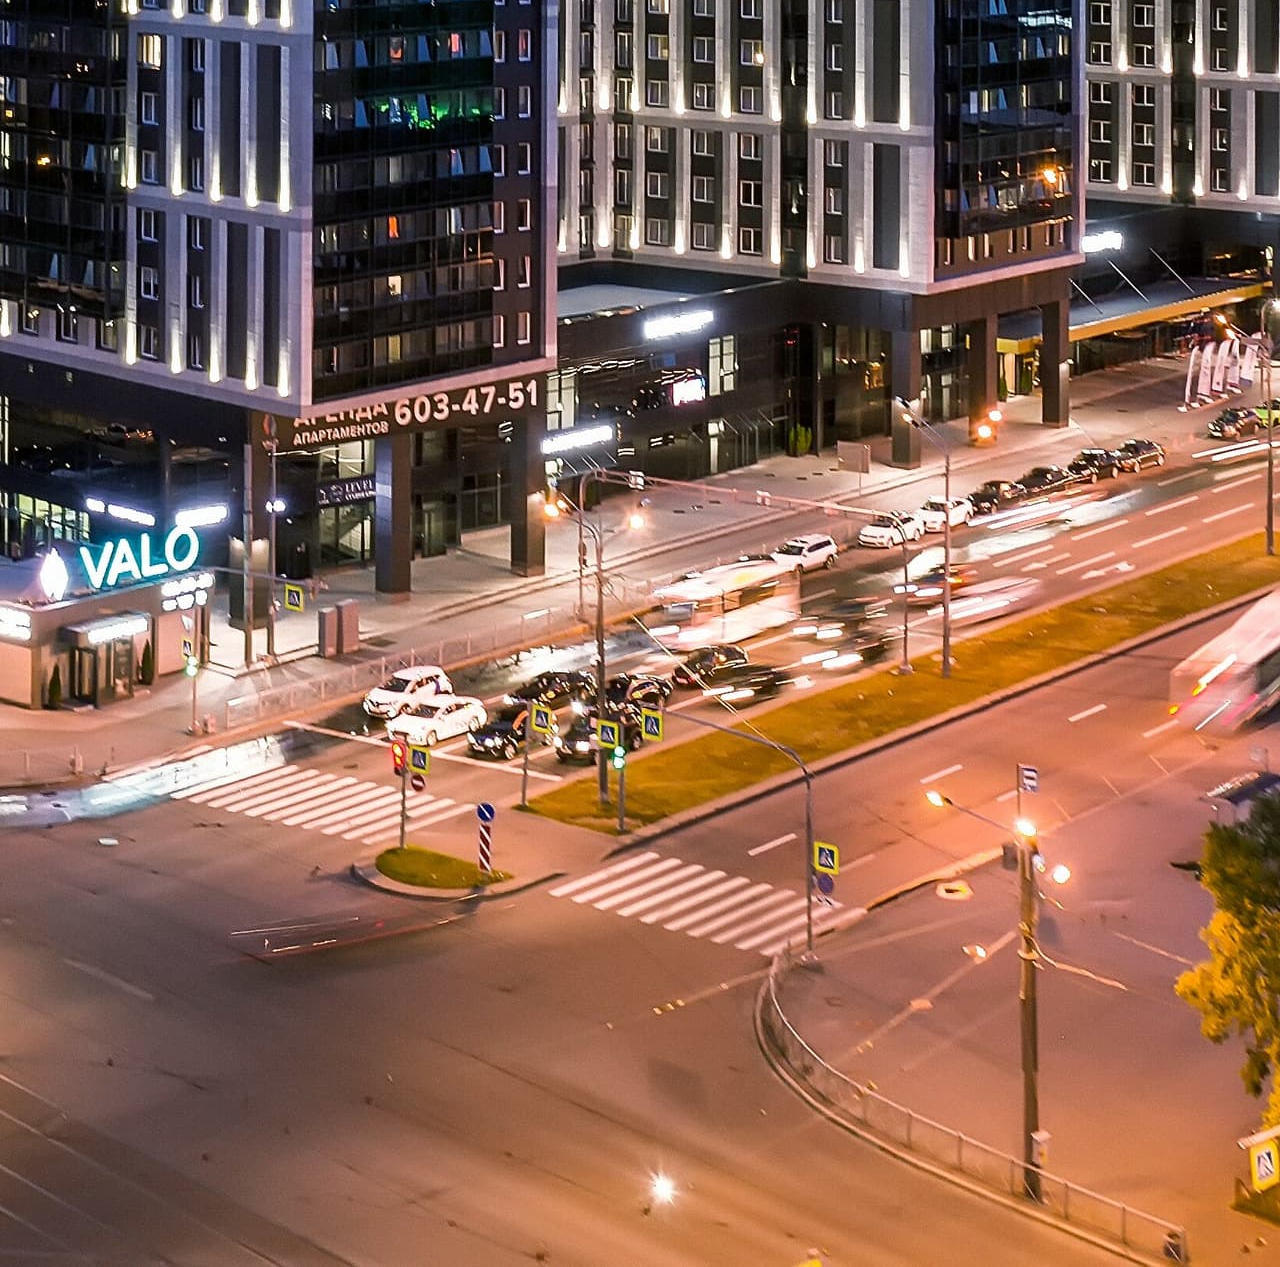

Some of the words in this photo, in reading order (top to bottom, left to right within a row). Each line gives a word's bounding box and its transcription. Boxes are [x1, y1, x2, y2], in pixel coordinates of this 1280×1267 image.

[395, 379, 537, 426] 603-47-51
[293, 420, 390, 446] АПАРТАМЕНТОВ
[79, 524, 199, 589] VALO
